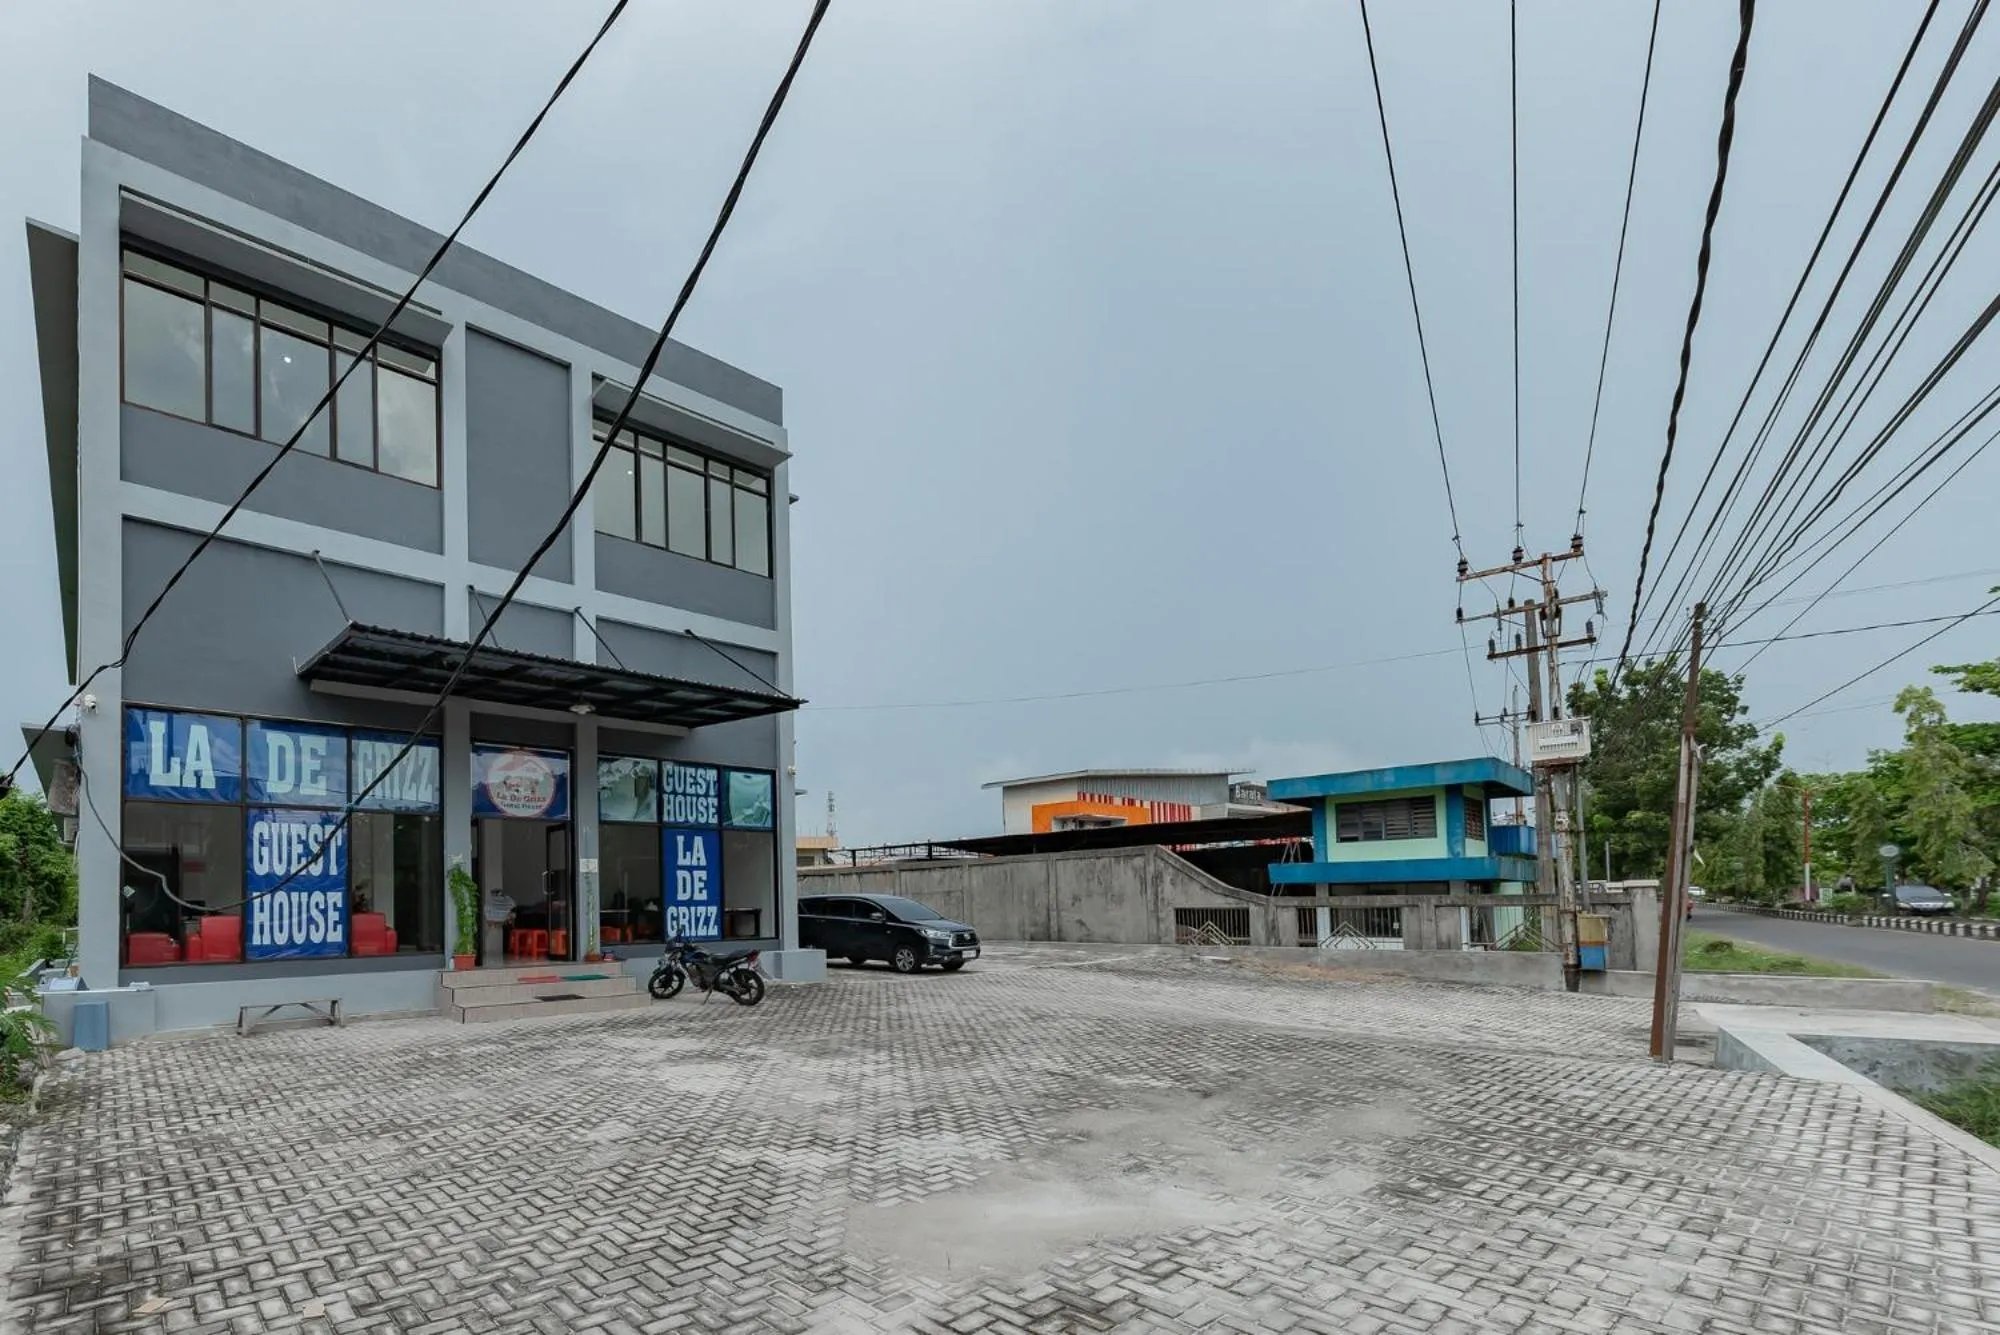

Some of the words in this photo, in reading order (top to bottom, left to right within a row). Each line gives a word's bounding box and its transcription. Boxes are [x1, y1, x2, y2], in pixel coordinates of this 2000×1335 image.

[149, 720, 216, 789] LA
[266, 731, 327, 796] DE
[357, 741, 435, 802] GRIZZ
[662, 762, 718, 796] GUEST
[663, 793, 718, 824] HOUSE
[252, 821, 342, 876] GUEST
[676, 835, 707, 867] LA
[676, 870, 707, 901] DE
[252, 891, 343, 945] HOUSE
[666, 906, 718, 937] GRIZZ
